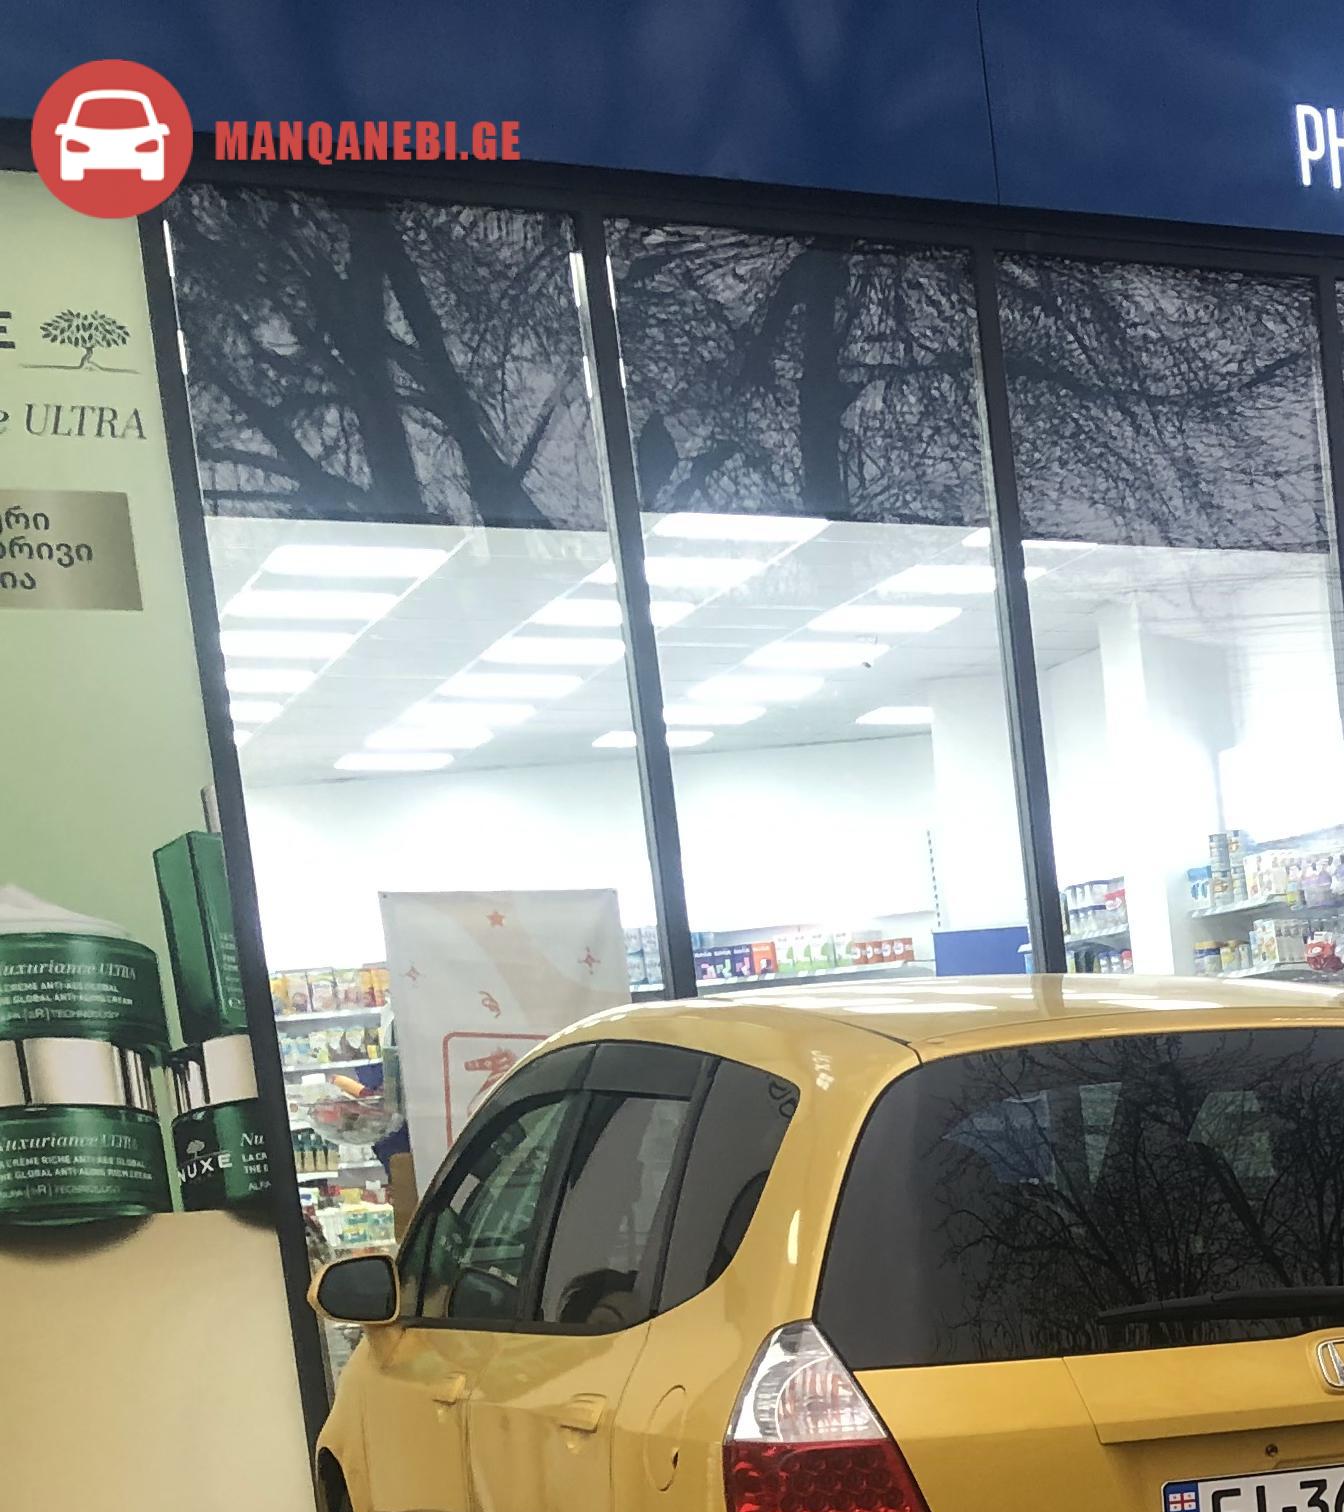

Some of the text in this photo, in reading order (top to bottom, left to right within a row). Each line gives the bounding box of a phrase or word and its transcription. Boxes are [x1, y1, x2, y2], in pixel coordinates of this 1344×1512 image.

[25, 403, 147, 440] ULTRA
[0, 505, 50, 535] რი
[0, 960, 97, 976] uxuriance
[0, 1132, 98, 1152] uxuriance
[177, 1153, 233, 1183] NUXE
